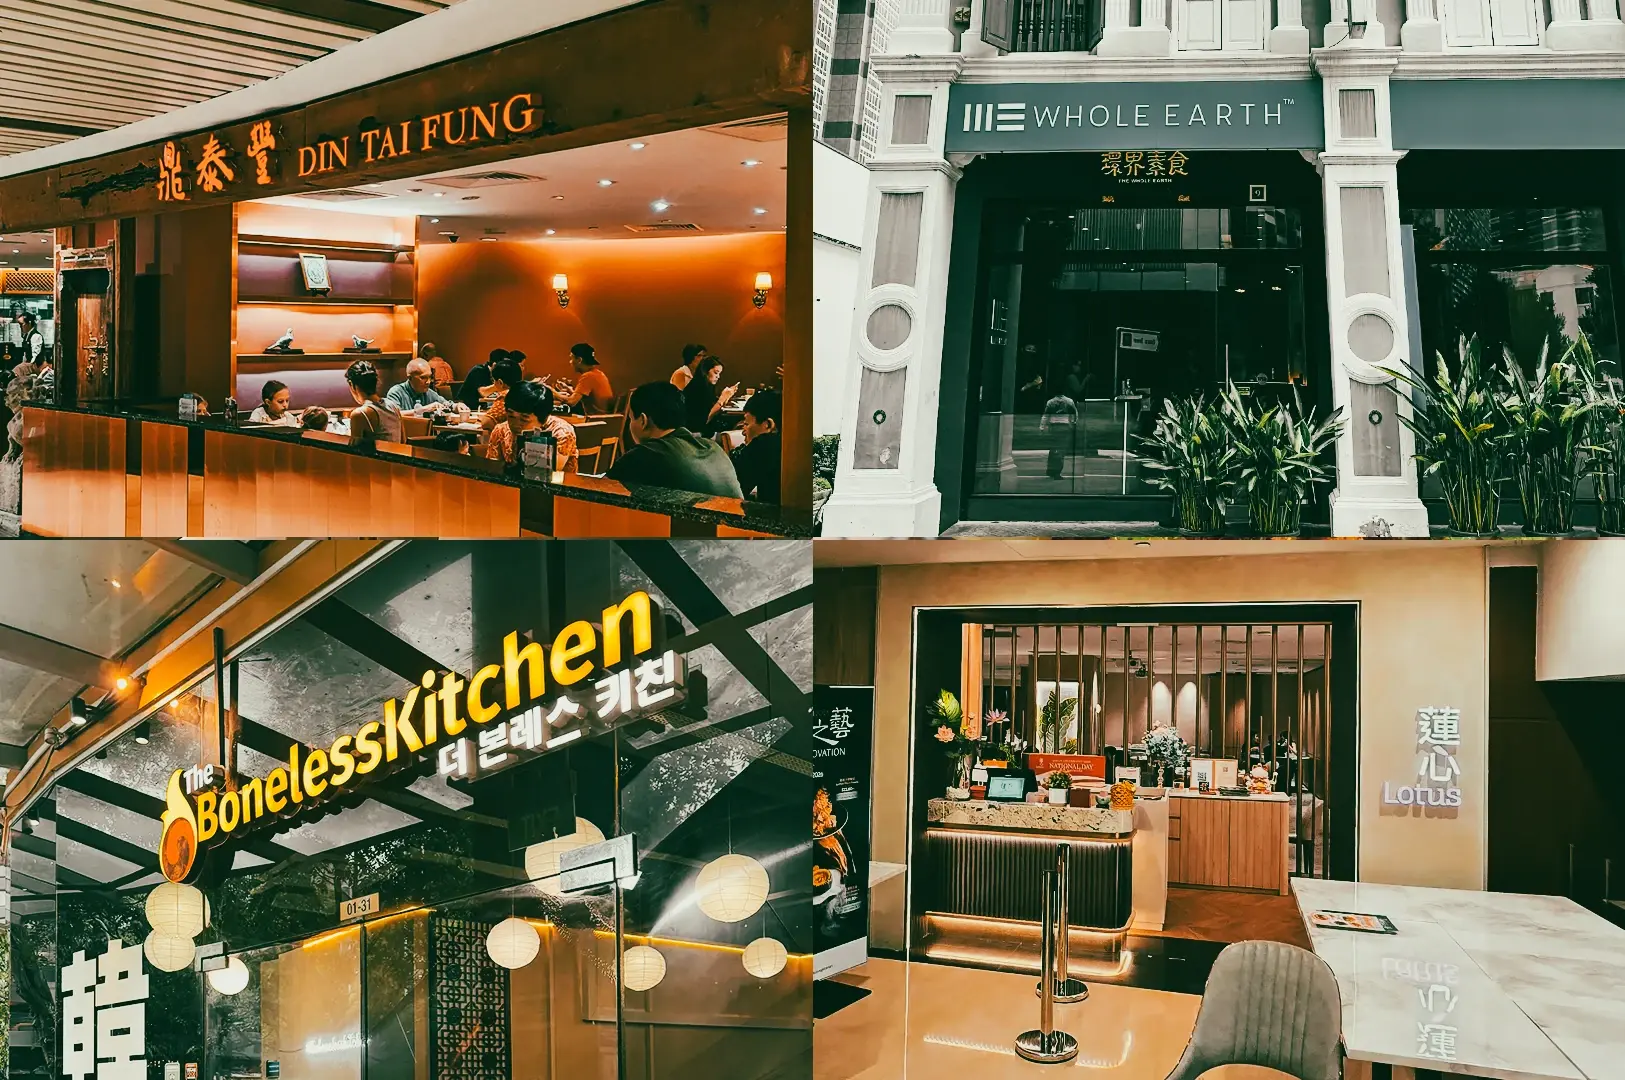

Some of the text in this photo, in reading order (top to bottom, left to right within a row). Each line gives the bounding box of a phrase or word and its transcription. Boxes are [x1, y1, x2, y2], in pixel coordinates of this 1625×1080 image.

[1033, 104, 1150, 128] WHOLE
[1165, 102, 1282, 126] EARTH
[298, 93, 535, 177] DIN TAI FUNG
[156, 120, 276, 202] 鼎泰豐
[1100, 150, 1190, 177] 環界素食
[438, 649, 675, 777] 더 본레스 키친
[1418, 705, 1461, 782] 蓮心
[183, 763, 214, 795] The
[1048, 762, 1080, 771] NATIONAL
[1081, 762, 1094, 771] DAY
[1384, 780, 1462, 807] Lotus
[346, 898, 371, 916] 01-31
[61, 938, 150, 1080] 韓
